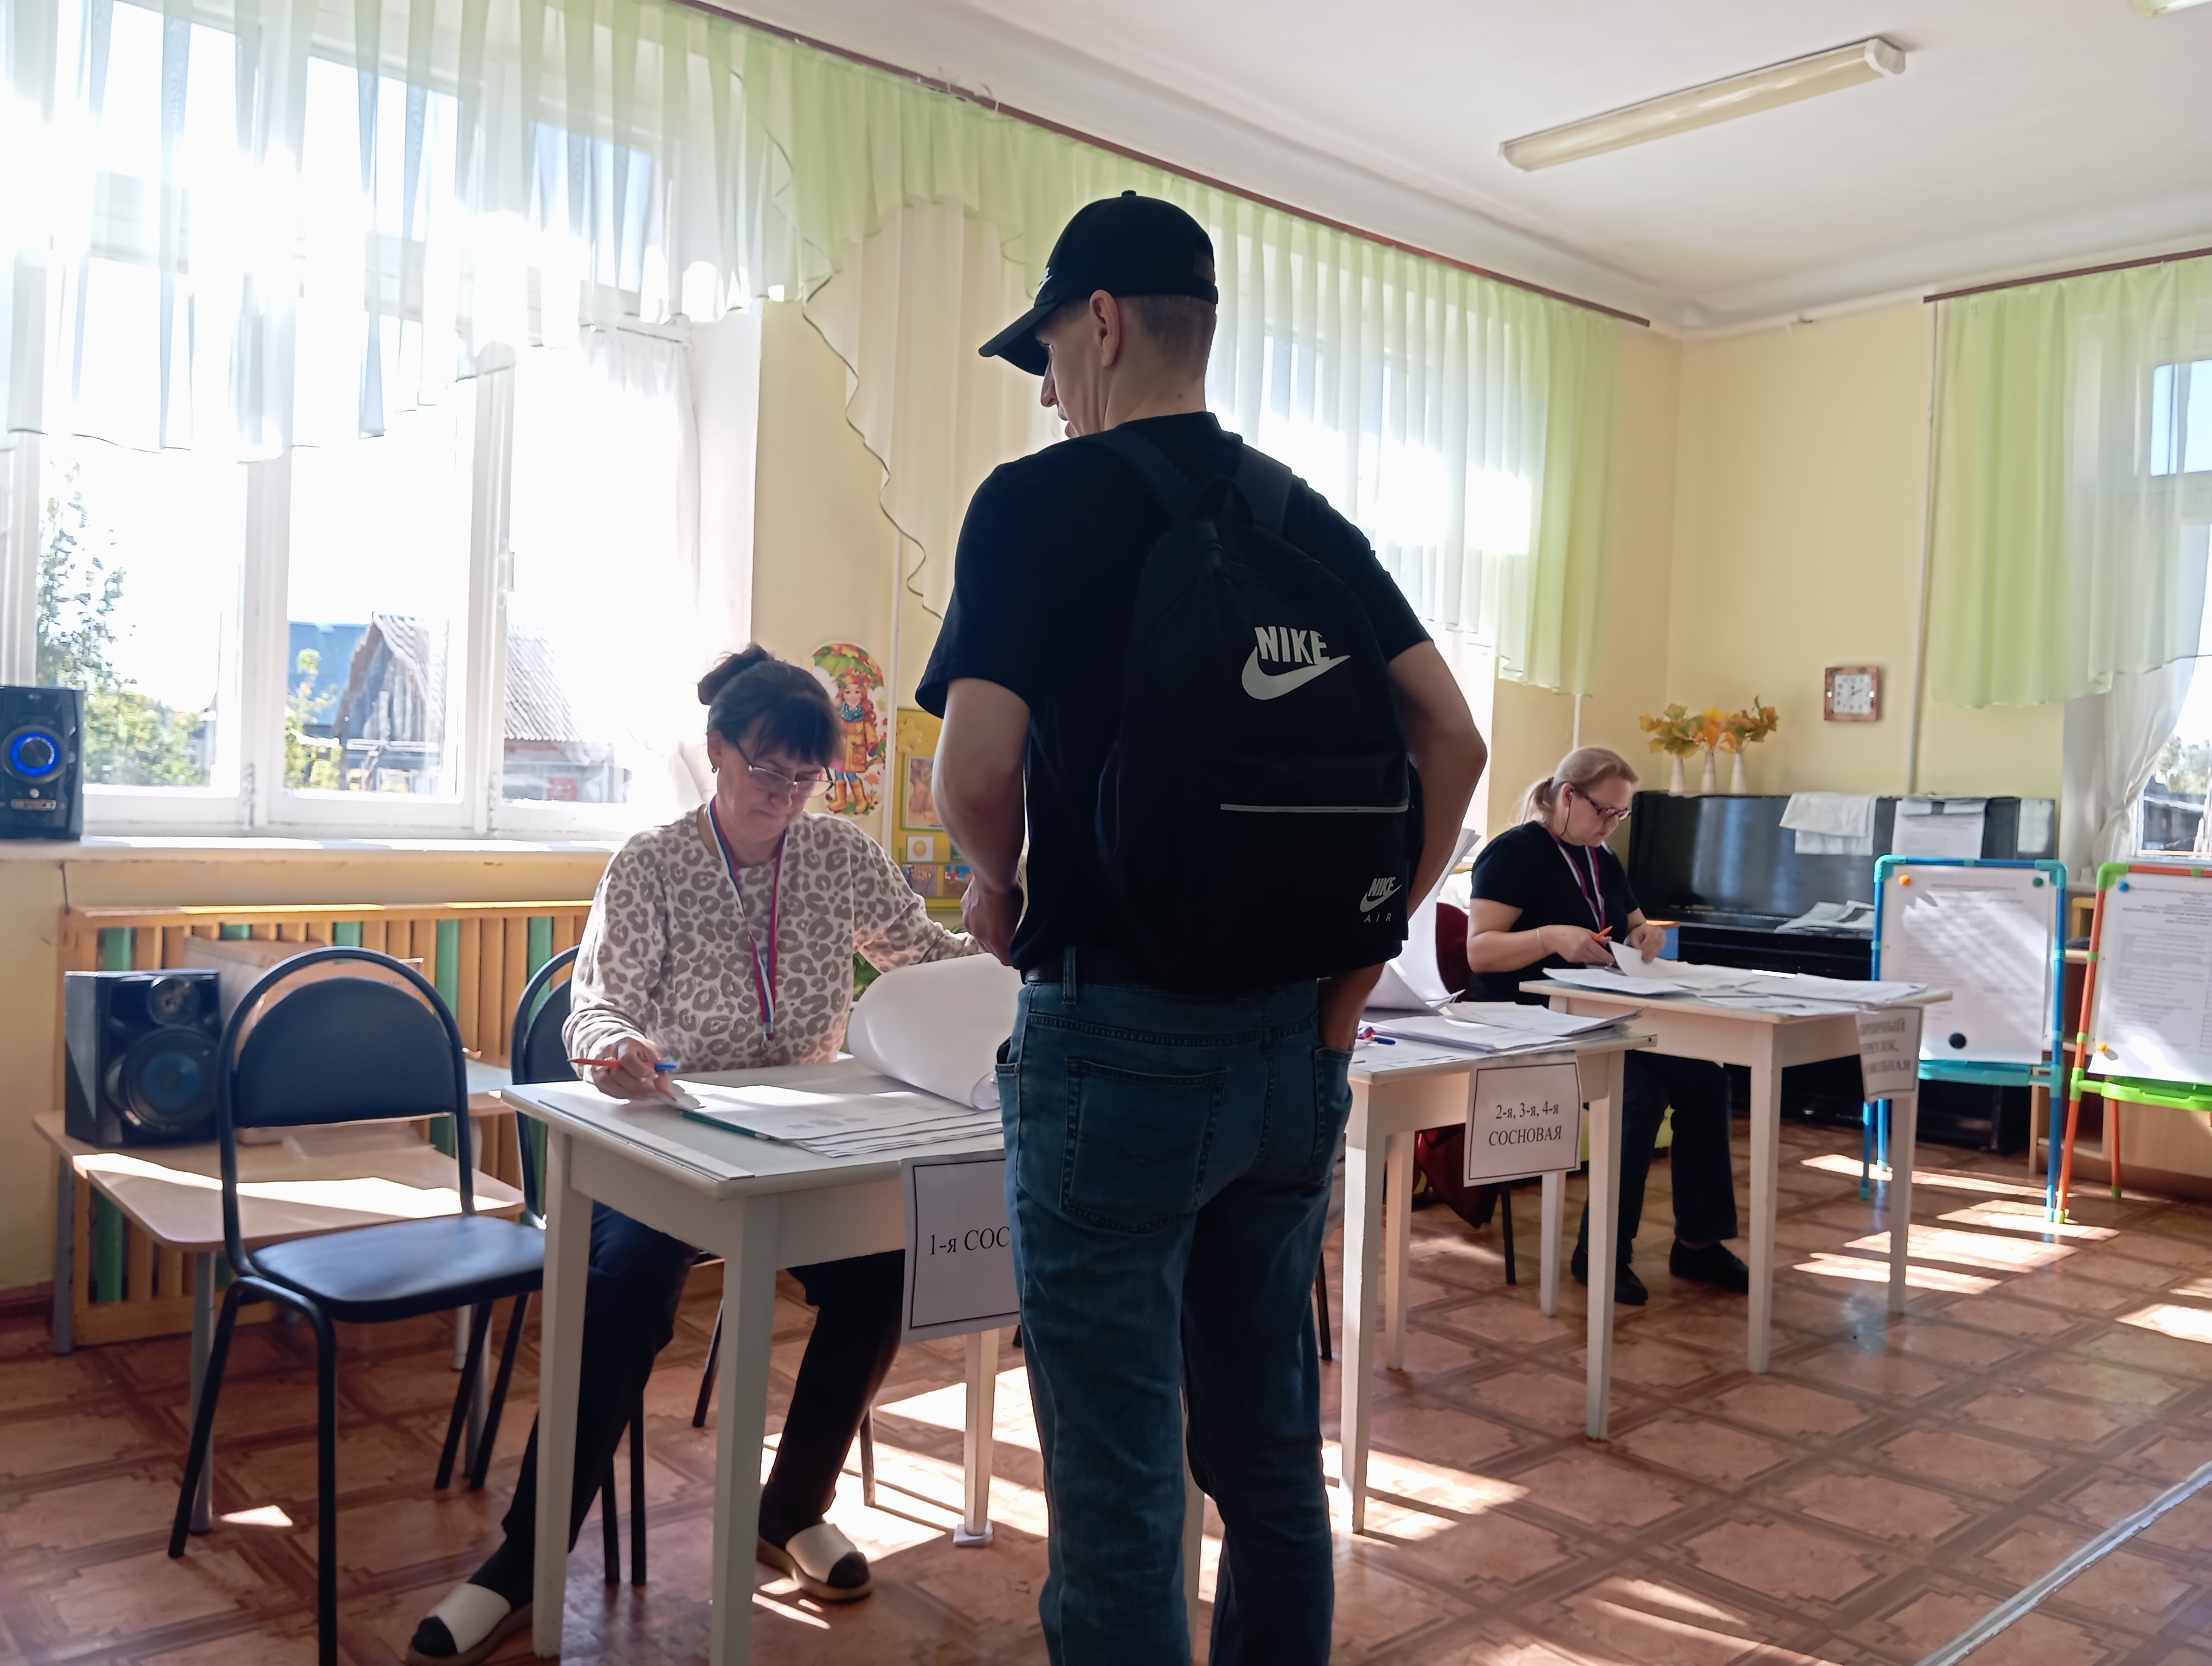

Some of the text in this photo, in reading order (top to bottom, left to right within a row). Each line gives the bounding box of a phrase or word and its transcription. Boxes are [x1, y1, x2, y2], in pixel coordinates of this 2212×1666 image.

[1254, 625, 1330, 665] NIKE
[1367, 876, 1397, 896] NIKE
[1363, 913, 1392, 923] AIR
[1495, 1101, 1559, 1120] 2-я, 3-я, 4-я
[1489, 1125, 1562, 1146] СОСНОВАЯ
[929, 1234, 957, 1255] 1-я
